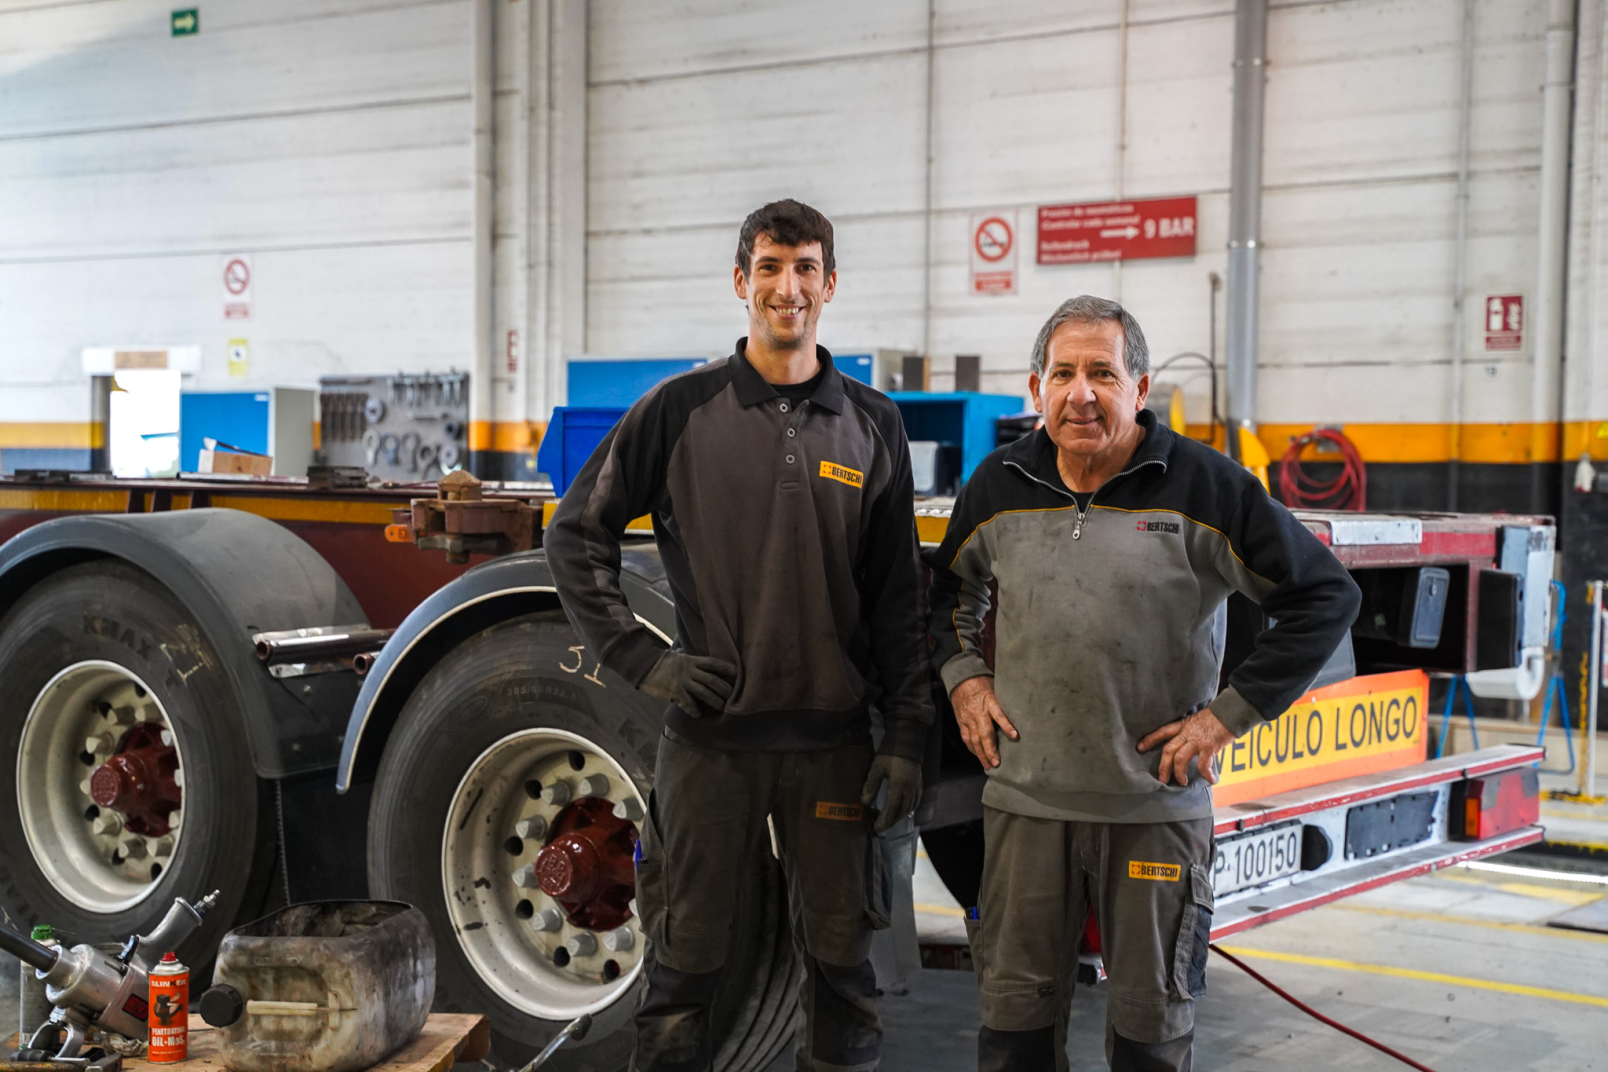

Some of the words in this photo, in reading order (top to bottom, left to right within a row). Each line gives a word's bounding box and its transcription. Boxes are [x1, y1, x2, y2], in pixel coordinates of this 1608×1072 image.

[1144, 218, 1156, 239] 9
[1159, 216, 1195, 238] BAR
[832, 466, 863, 485] BERTSCHI
[1147, 521, 1180, 534] BERTSCHI
[1335, 696, 1417, 752] LONGO
[828, 806, 861, 818] BERTSCHI
[1141, 865, 1178, 878] BERTSCHI
[151, 979, 186, 987] BLINKER
